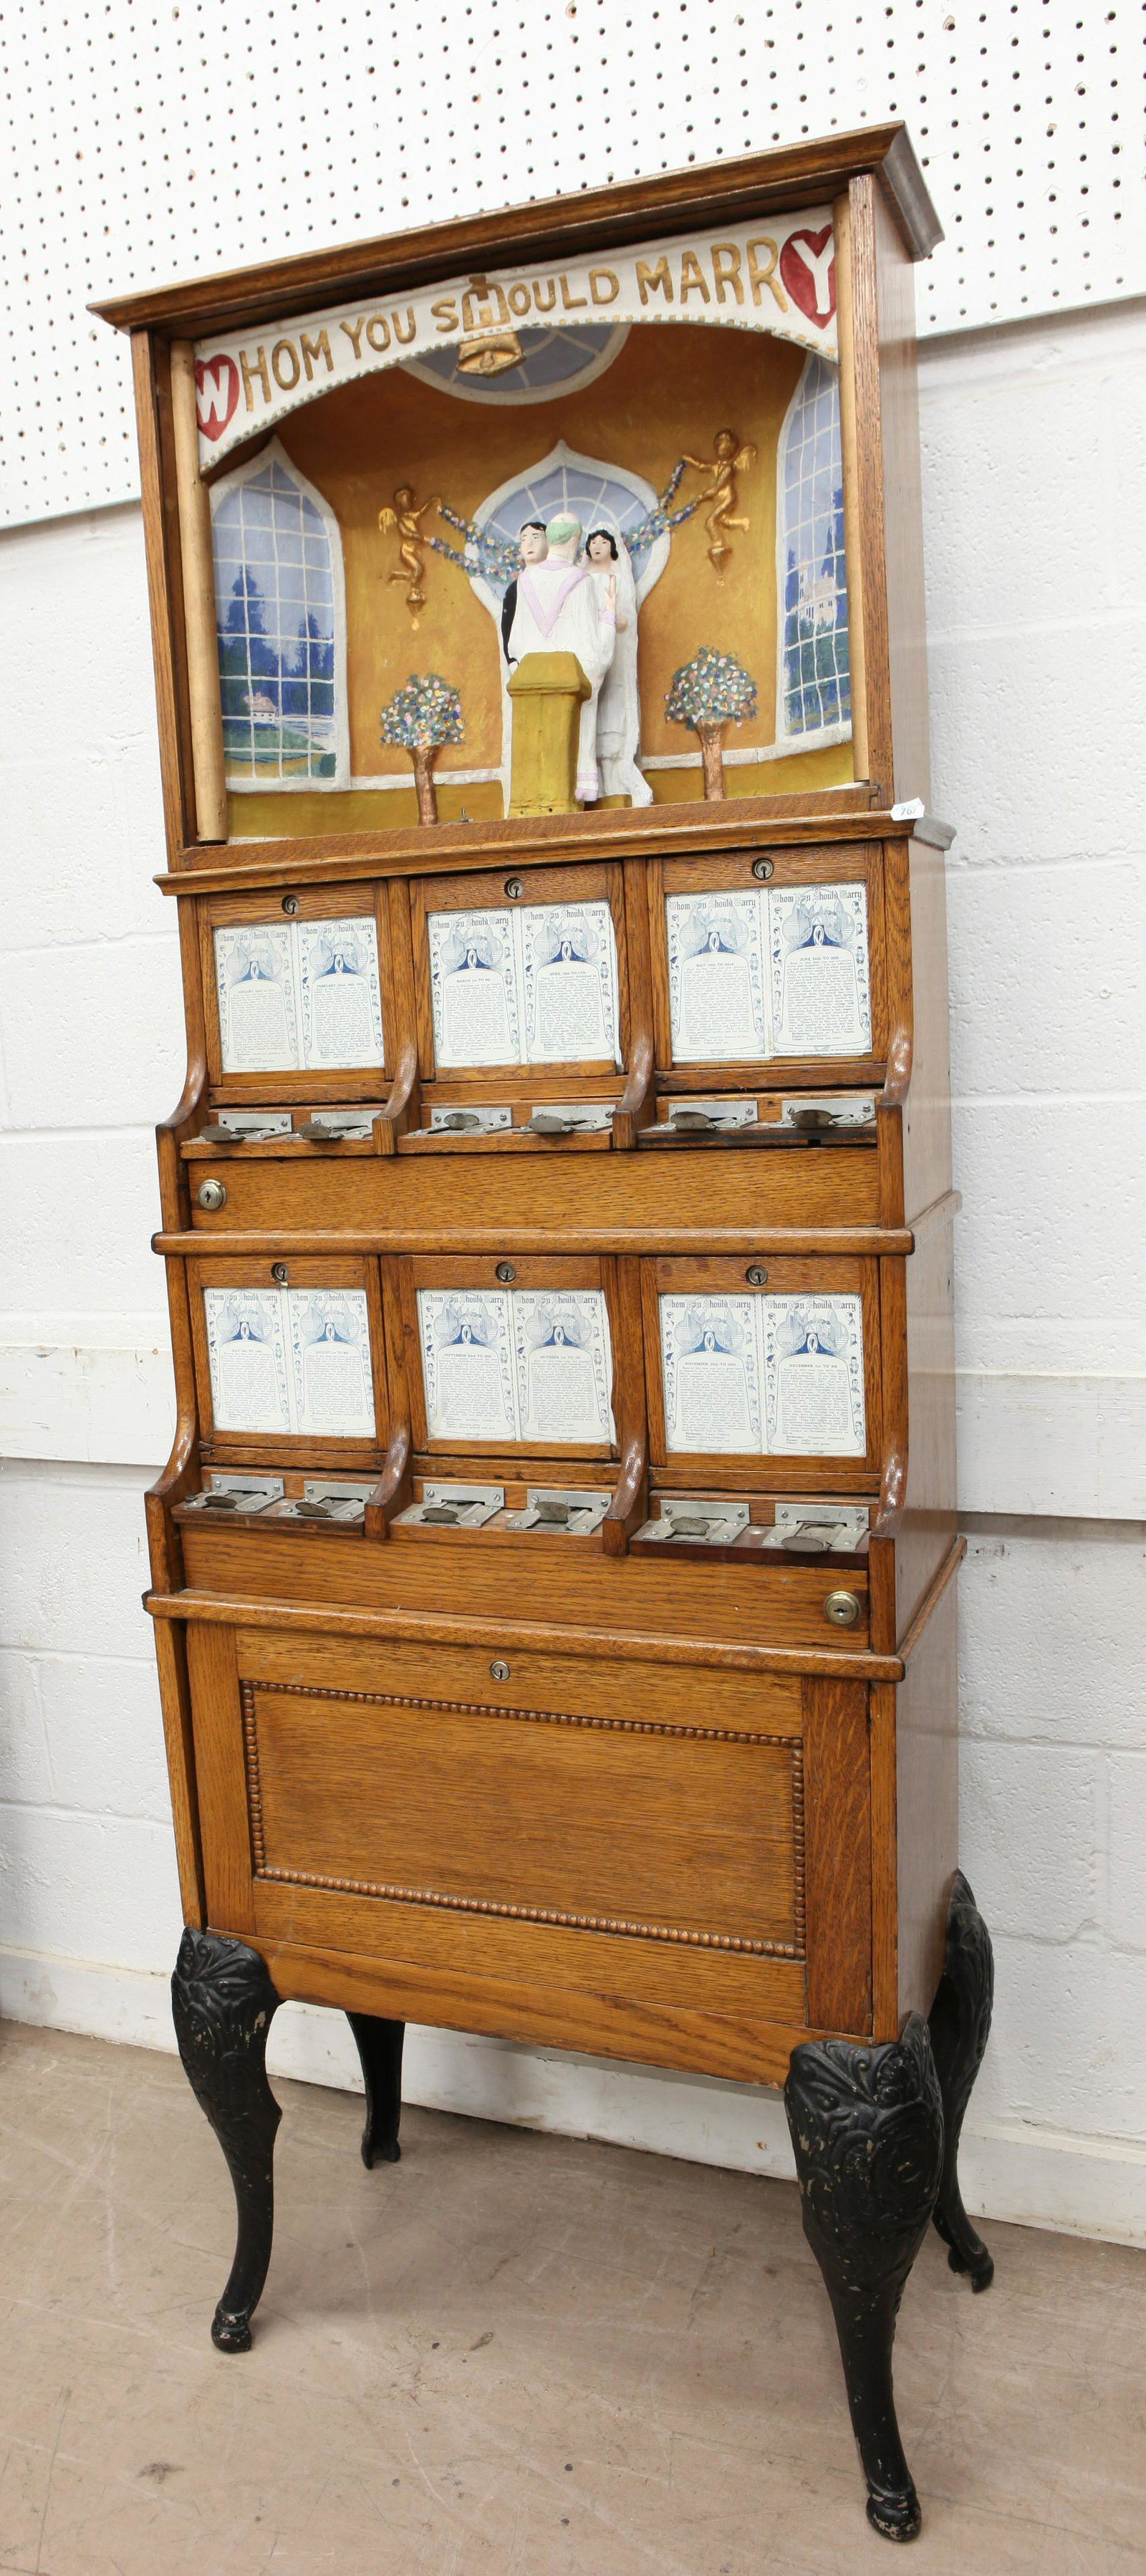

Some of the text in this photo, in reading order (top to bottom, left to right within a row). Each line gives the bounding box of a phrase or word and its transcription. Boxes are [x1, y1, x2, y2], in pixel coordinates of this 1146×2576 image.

[195, 233, 835, 424] WHOM YOU SHOULD MARRY
